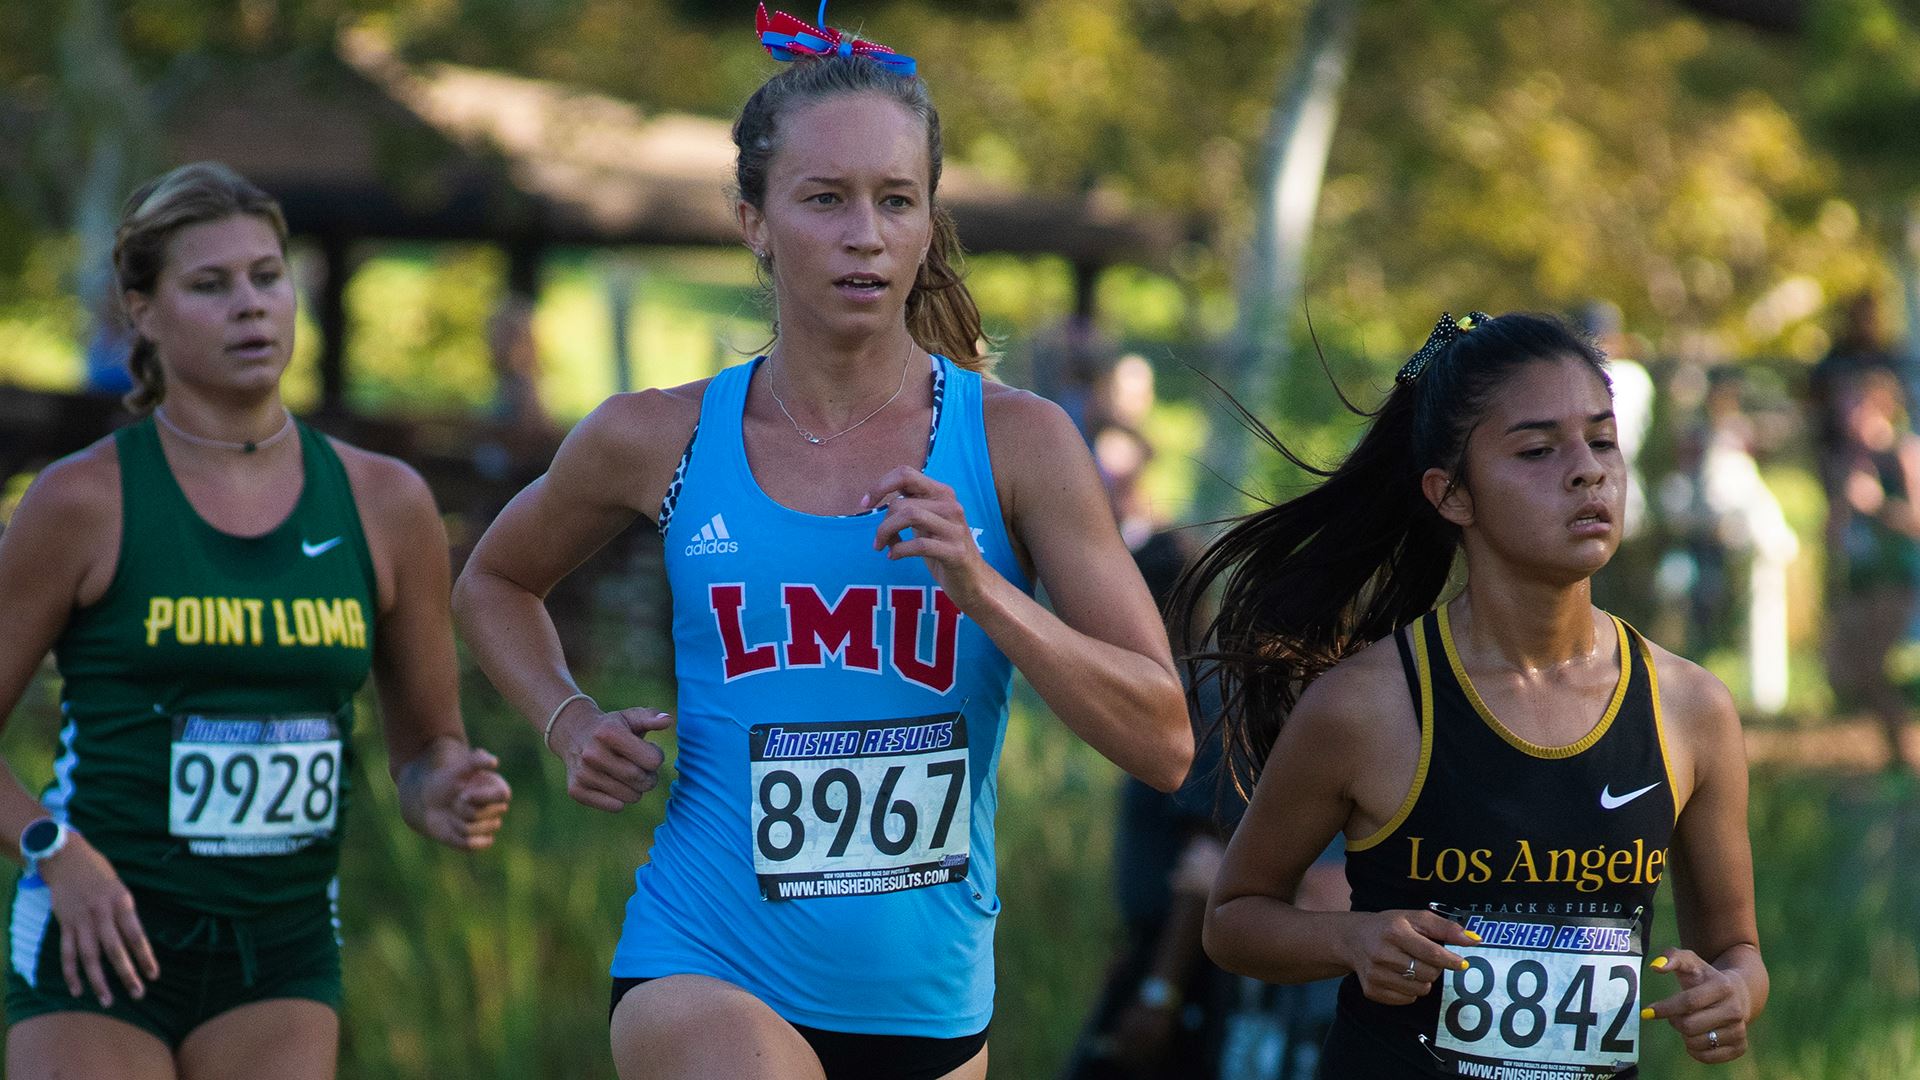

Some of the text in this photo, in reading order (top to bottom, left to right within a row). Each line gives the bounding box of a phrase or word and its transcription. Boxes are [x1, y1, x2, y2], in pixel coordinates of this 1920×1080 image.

[685, 539, 738, 556] adidas
[144, 597, 367, 649] POINT LOMA
[708, 582, 963, 697] LMU
[763, 722, 953, 758] FINISHED RESULTS
[176, 752, 334, 824] 9928
[757, 759, 966, 861] 8967
[778, 869, 950, 897] WWW.FINISHEDRESULTS.COM
[1407, 836, 1493, 884] Los
[1470, 902, 1623, 913] TRACK & FIELD
[1464, 915, 1631, 952] FINISHED RESULTS
[1445, 955, 1638, 1053] 8842
